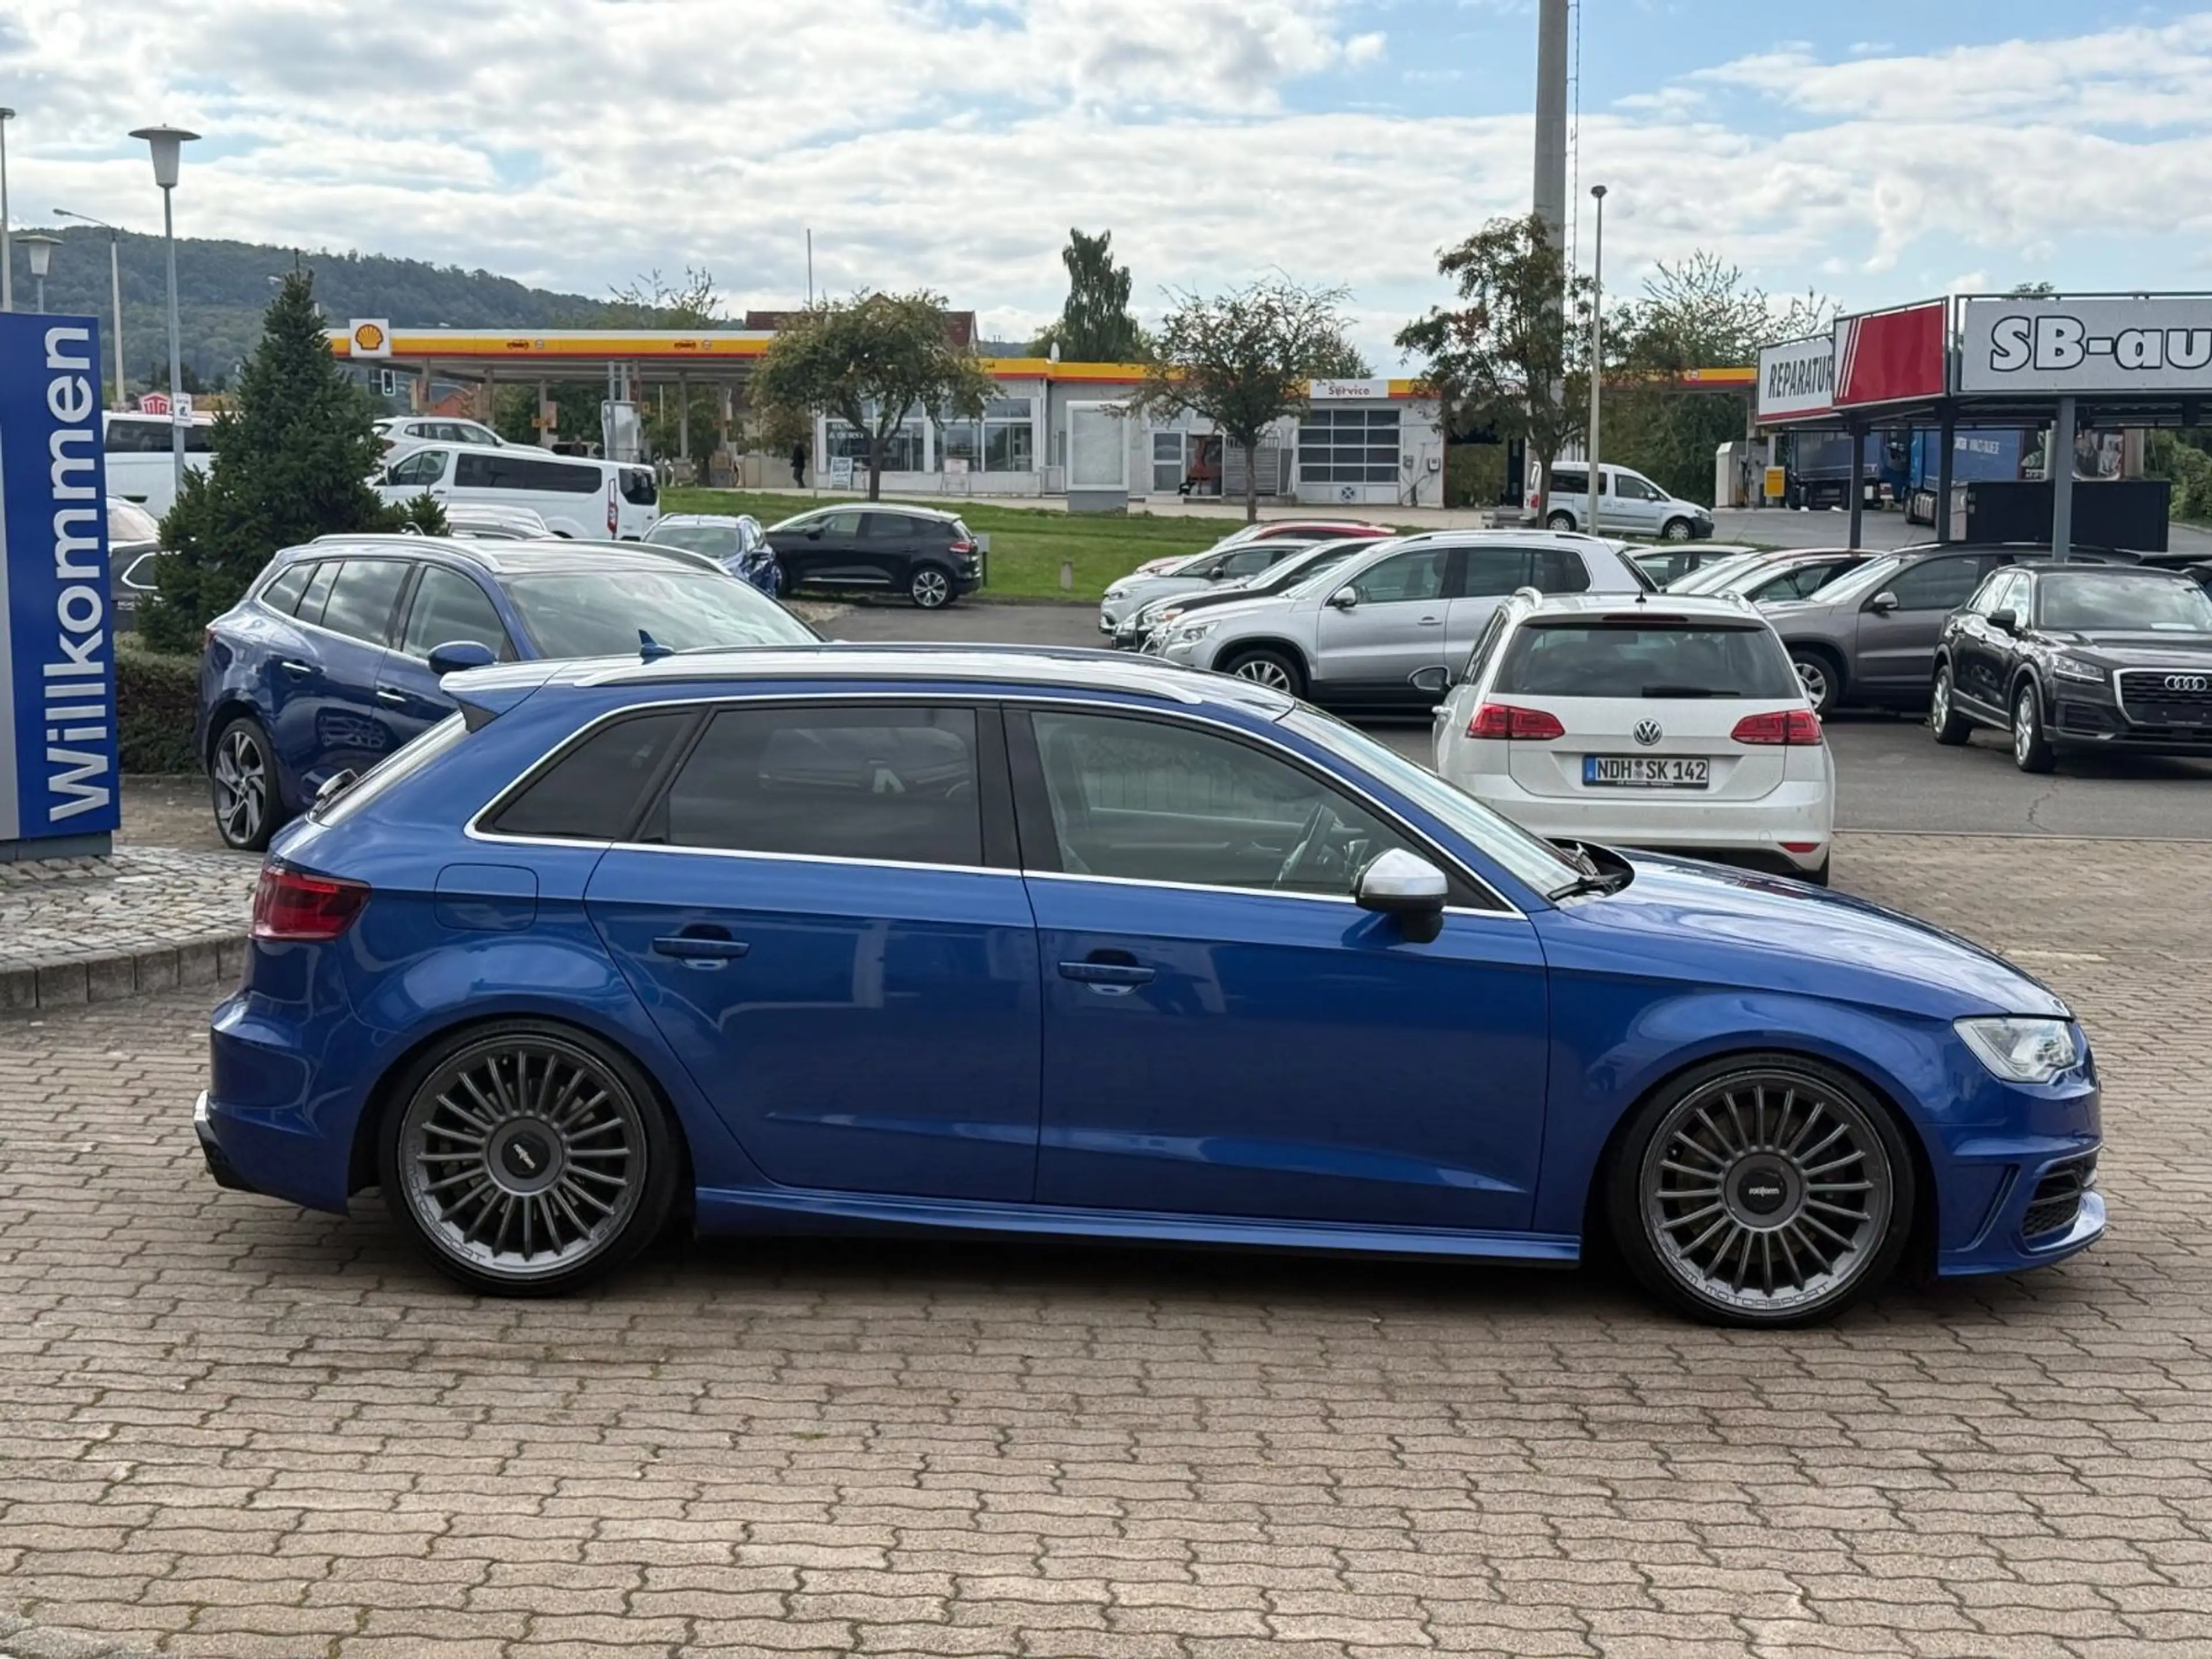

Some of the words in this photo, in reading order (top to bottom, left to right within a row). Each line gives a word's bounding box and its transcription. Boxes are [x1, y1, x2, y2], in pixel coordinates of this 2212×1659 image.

[1328, 384, 1370, 396] Service
[43, 327, 109, 822] Willkommen
[1597, 760, 1632, 779] NDH
[1646, 762, 1668, 781] SK
[1672, 762, 1707, 781] 142
[1705, 1281, 1829, 1308] MOTORSPORT
